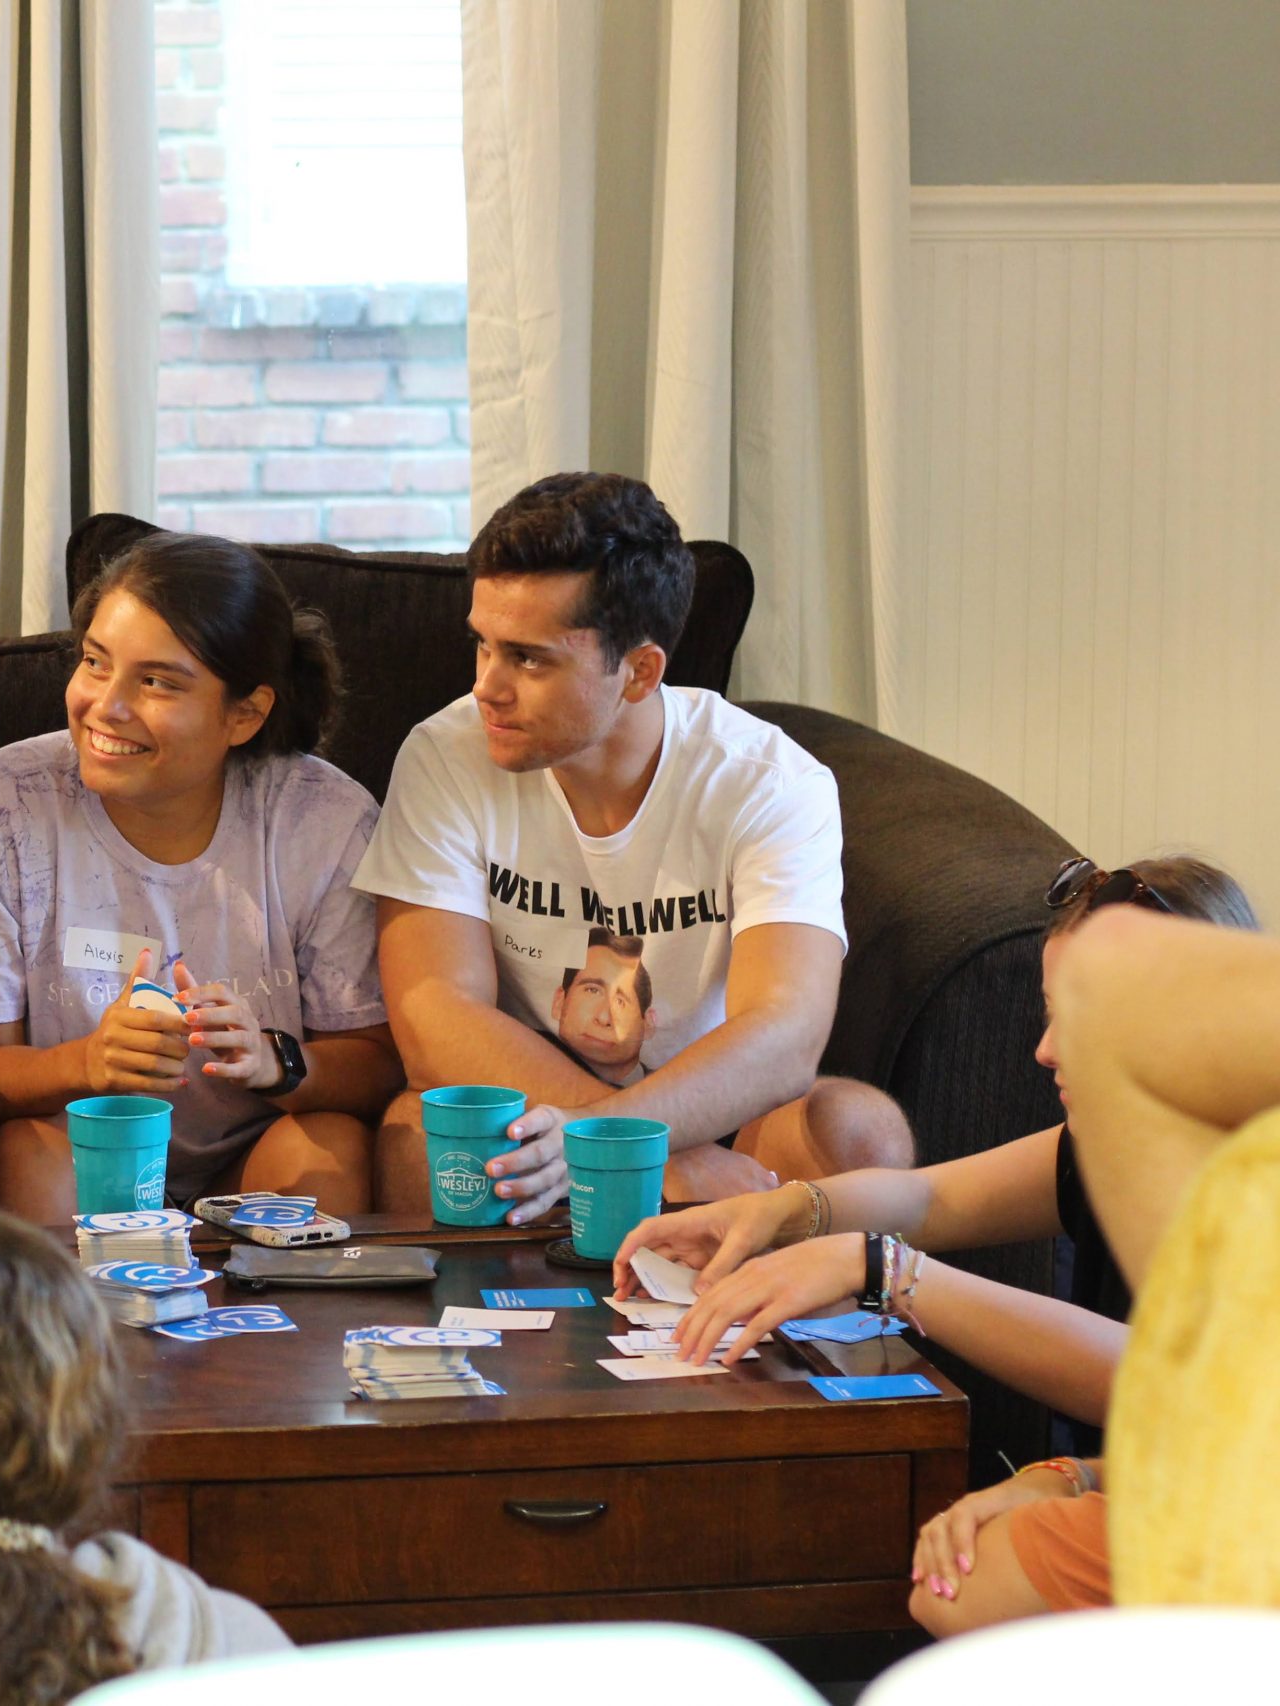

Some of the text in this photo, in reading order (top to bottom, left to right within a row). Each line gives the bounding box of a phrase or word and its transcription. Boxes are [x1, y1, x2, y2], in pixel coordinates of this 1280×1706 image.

[489, 862, 726, 936] WELL WELL WELL
[84, 943, 124, 964] Alexis
[504, 934, 543, 960] Parks
[440, 1177, 482, 1192] WESLEY
